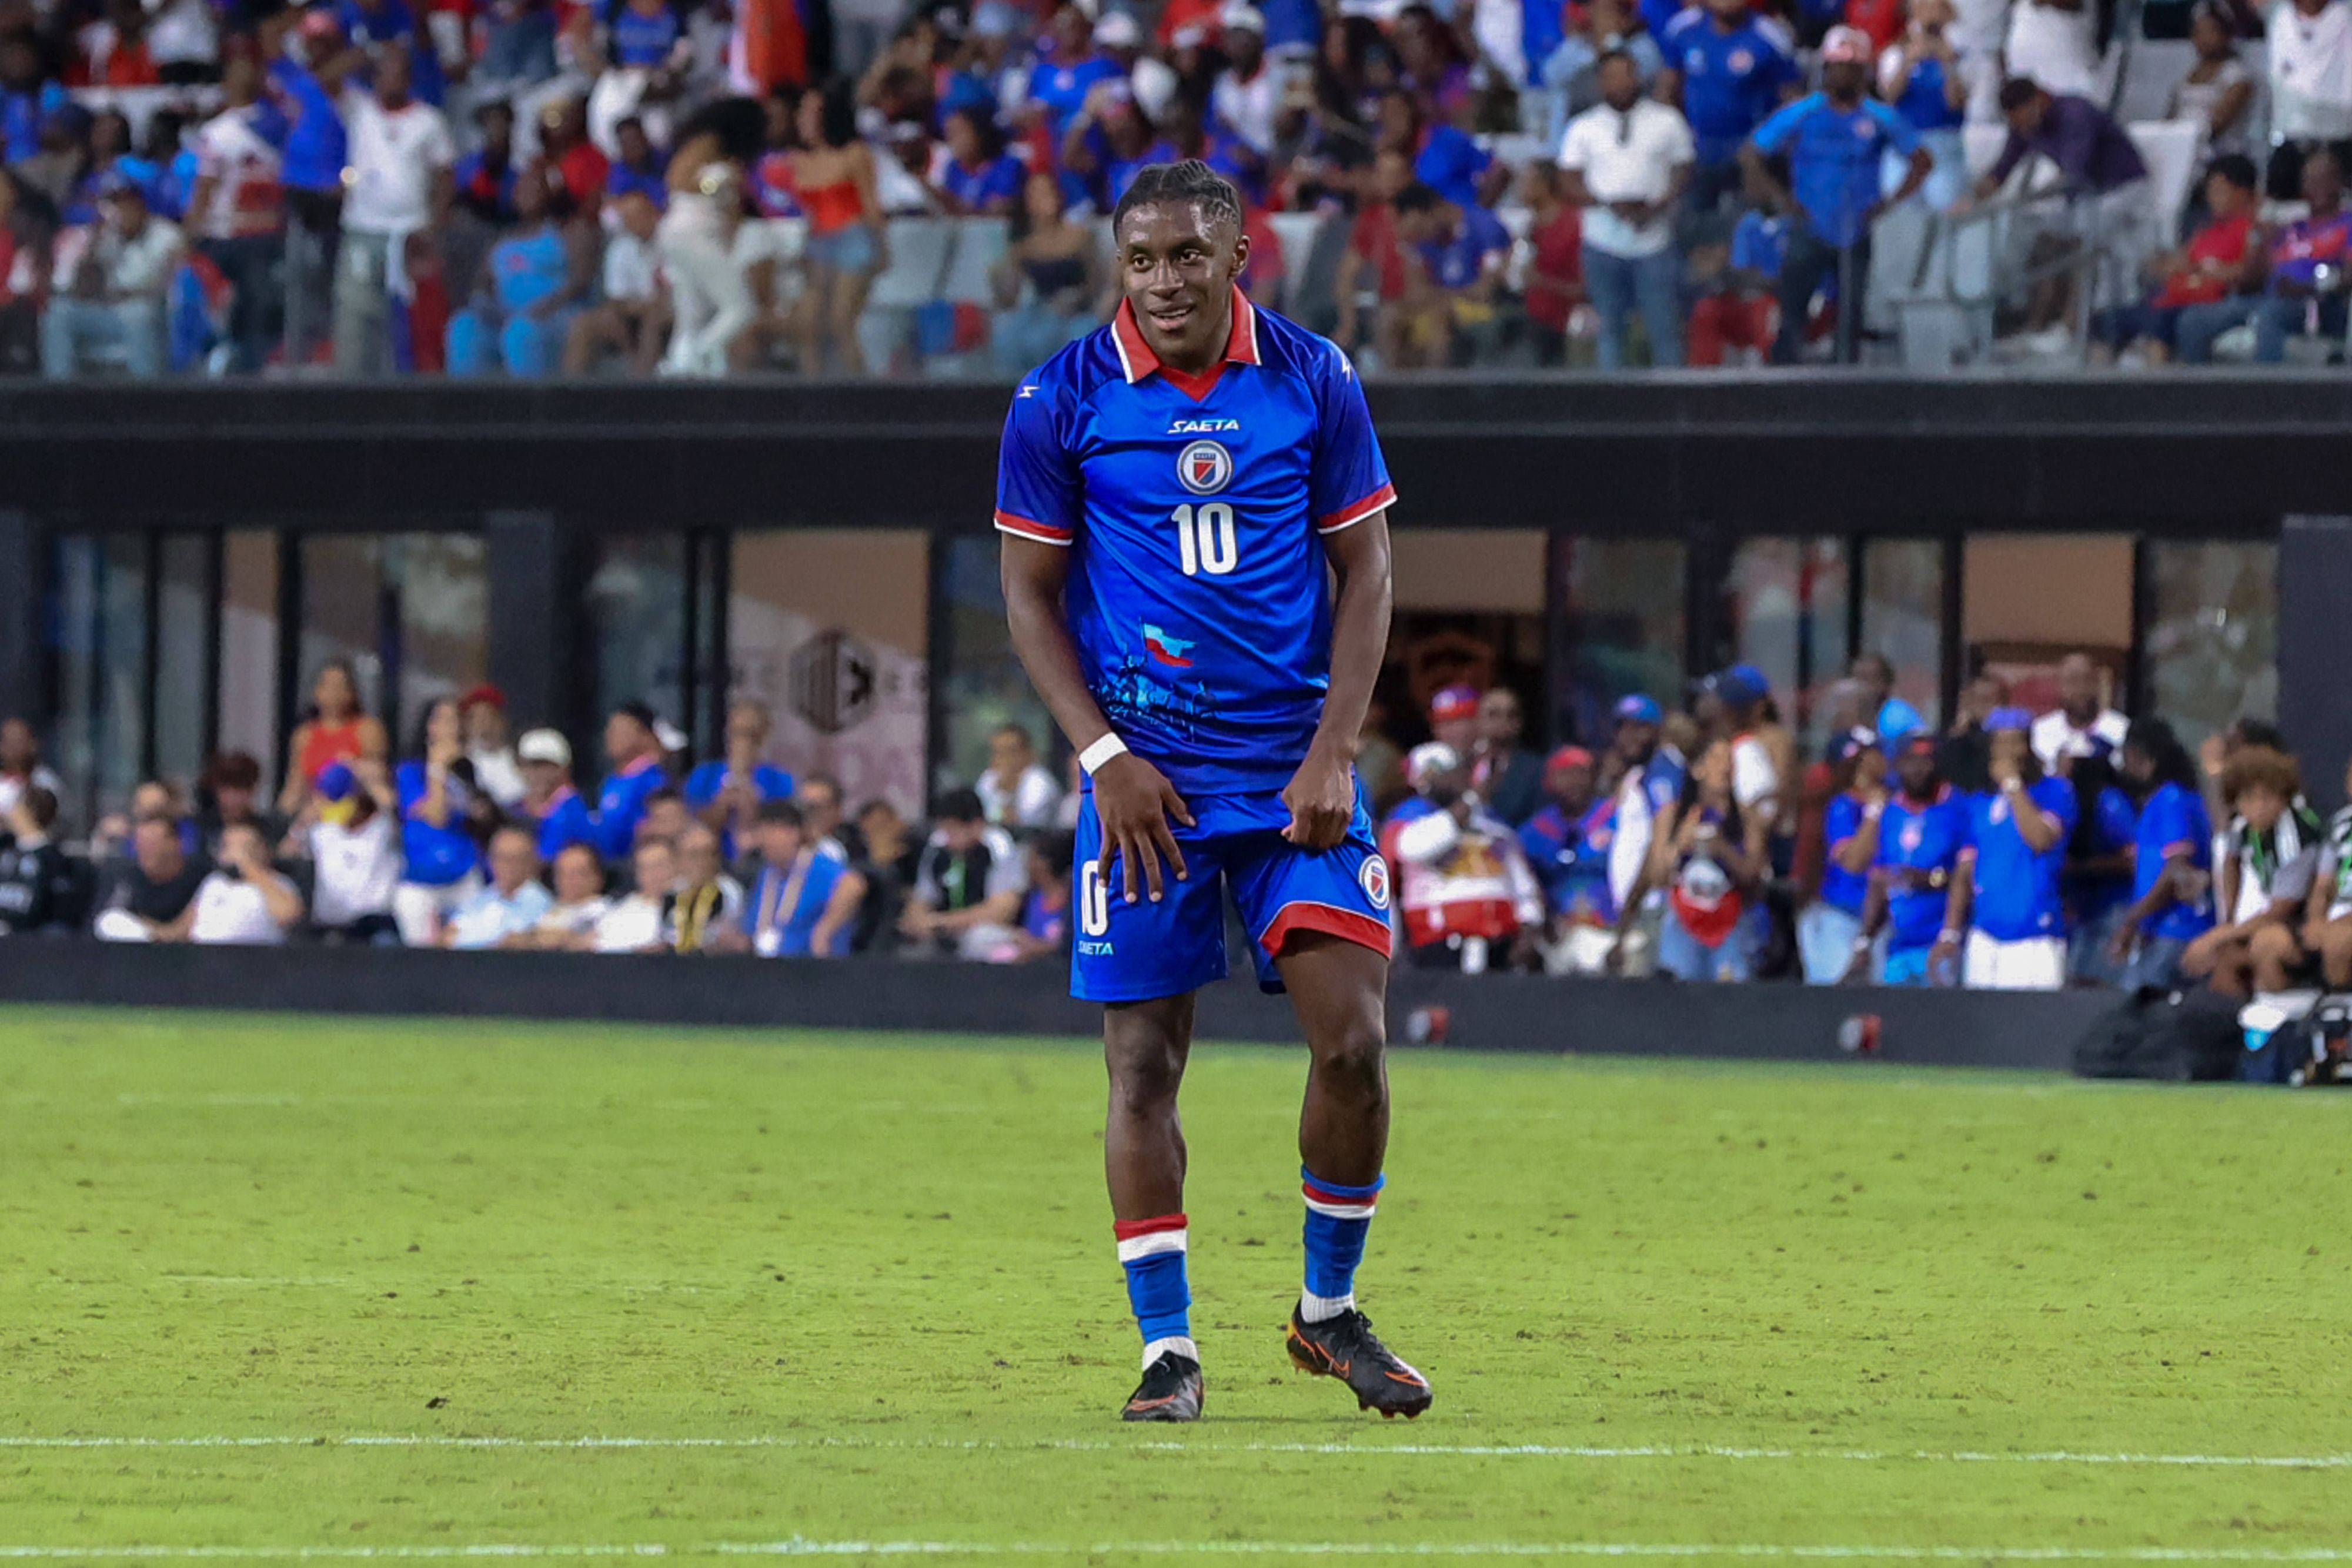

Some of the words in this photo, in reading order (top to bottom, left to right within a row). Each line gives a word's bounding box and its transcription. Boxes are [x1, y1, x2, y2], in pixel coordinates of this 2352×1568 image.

[1167, 419, 1240, 434] SAETA
[1171, 503, 1237, 576] 10
[1081, 860, 1108, 936] 0
